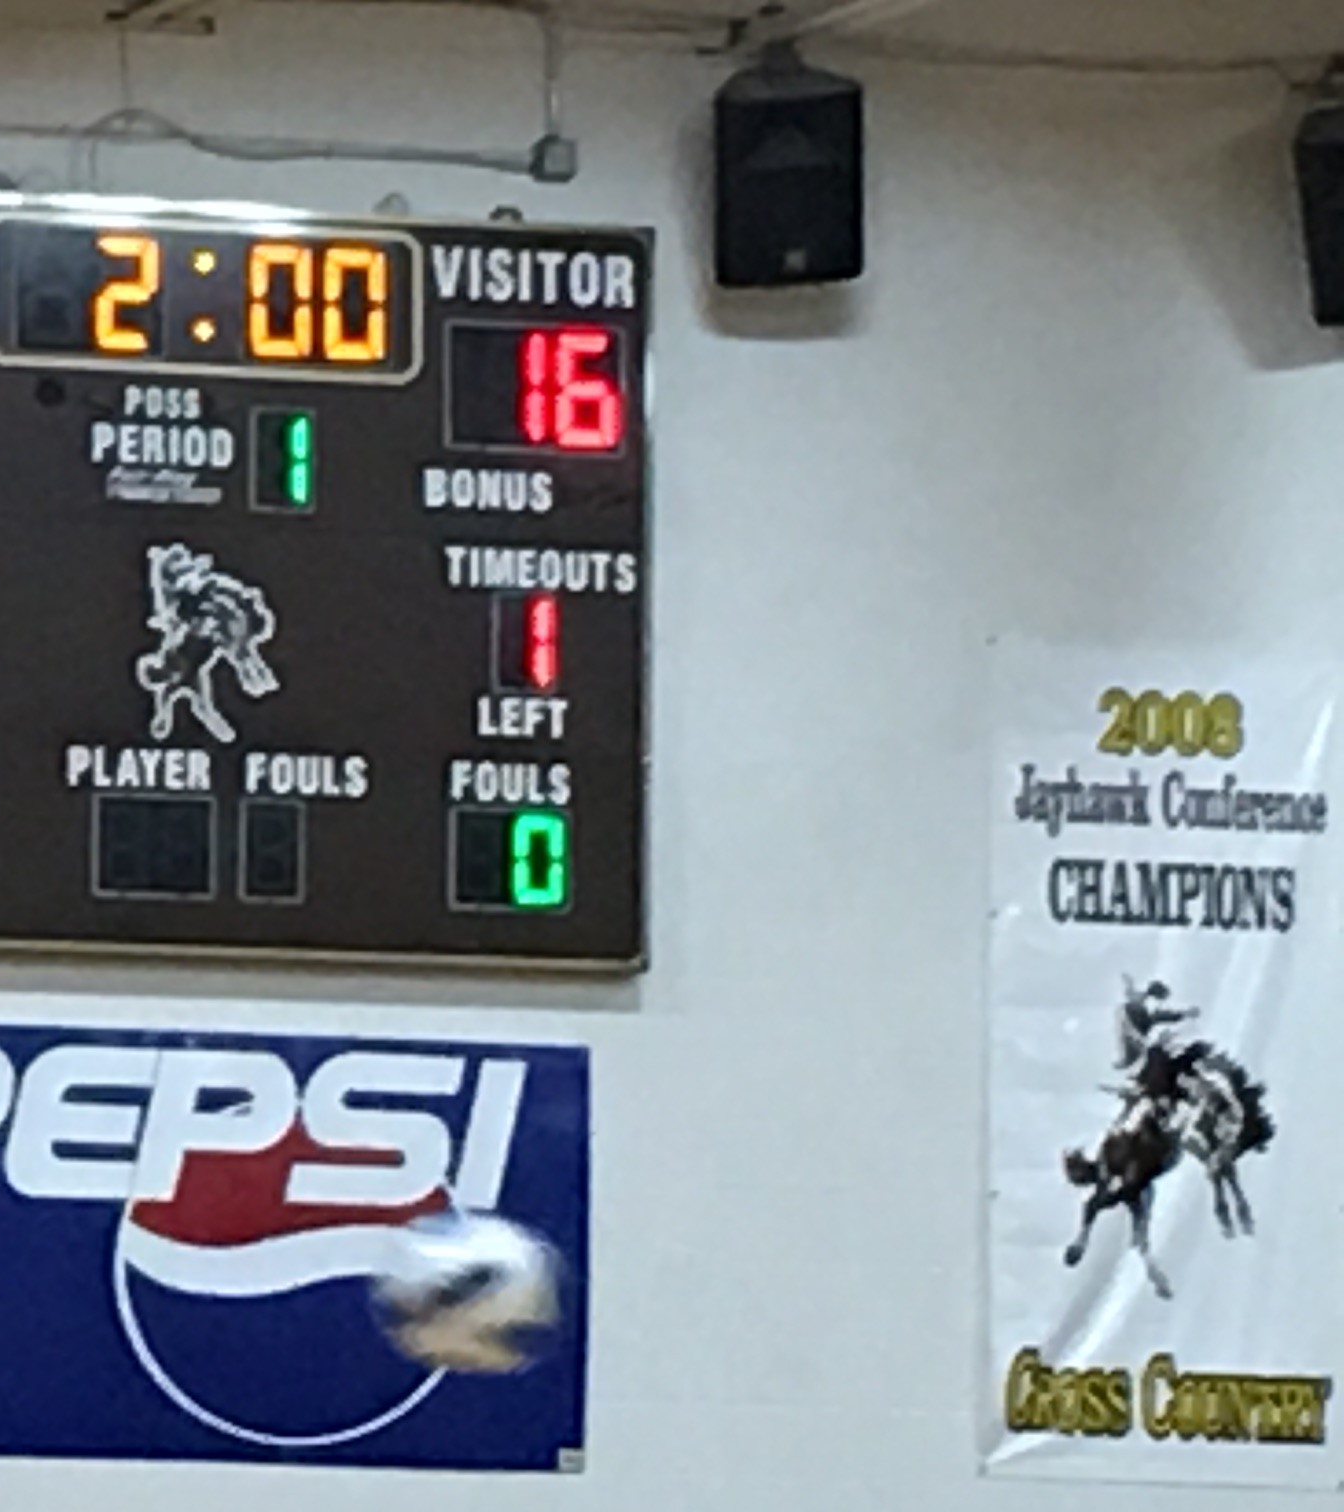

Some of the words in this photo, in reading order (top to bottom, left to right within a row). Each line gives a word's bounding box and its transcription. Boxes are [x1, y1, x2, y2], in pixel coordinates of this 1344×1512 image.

[93, 231, 387, 361] 2:00
[431, 245, 635, 308] VISITOR
[124, 385, 200, 419] POSS
[521, 327, 622, 449] 16
[91, 421, 234, 468] PERIOD
[289, 415, 308, 504] 1
[423, 468, 553, 511] BONUS
[444, 545, 636, 592] TIMEOUTS
[526, 595, 558, 689] 1
[477, 698, 568, 738] LEFT
[66, 744, 211, 790] PLAYER
[245, 753, 368, 797] FOULS
[450, 760, 571, 804] FOULS
[513, 813, 565, 906] 0
[1048, 858, 1295, 933] CHAMPIONS
